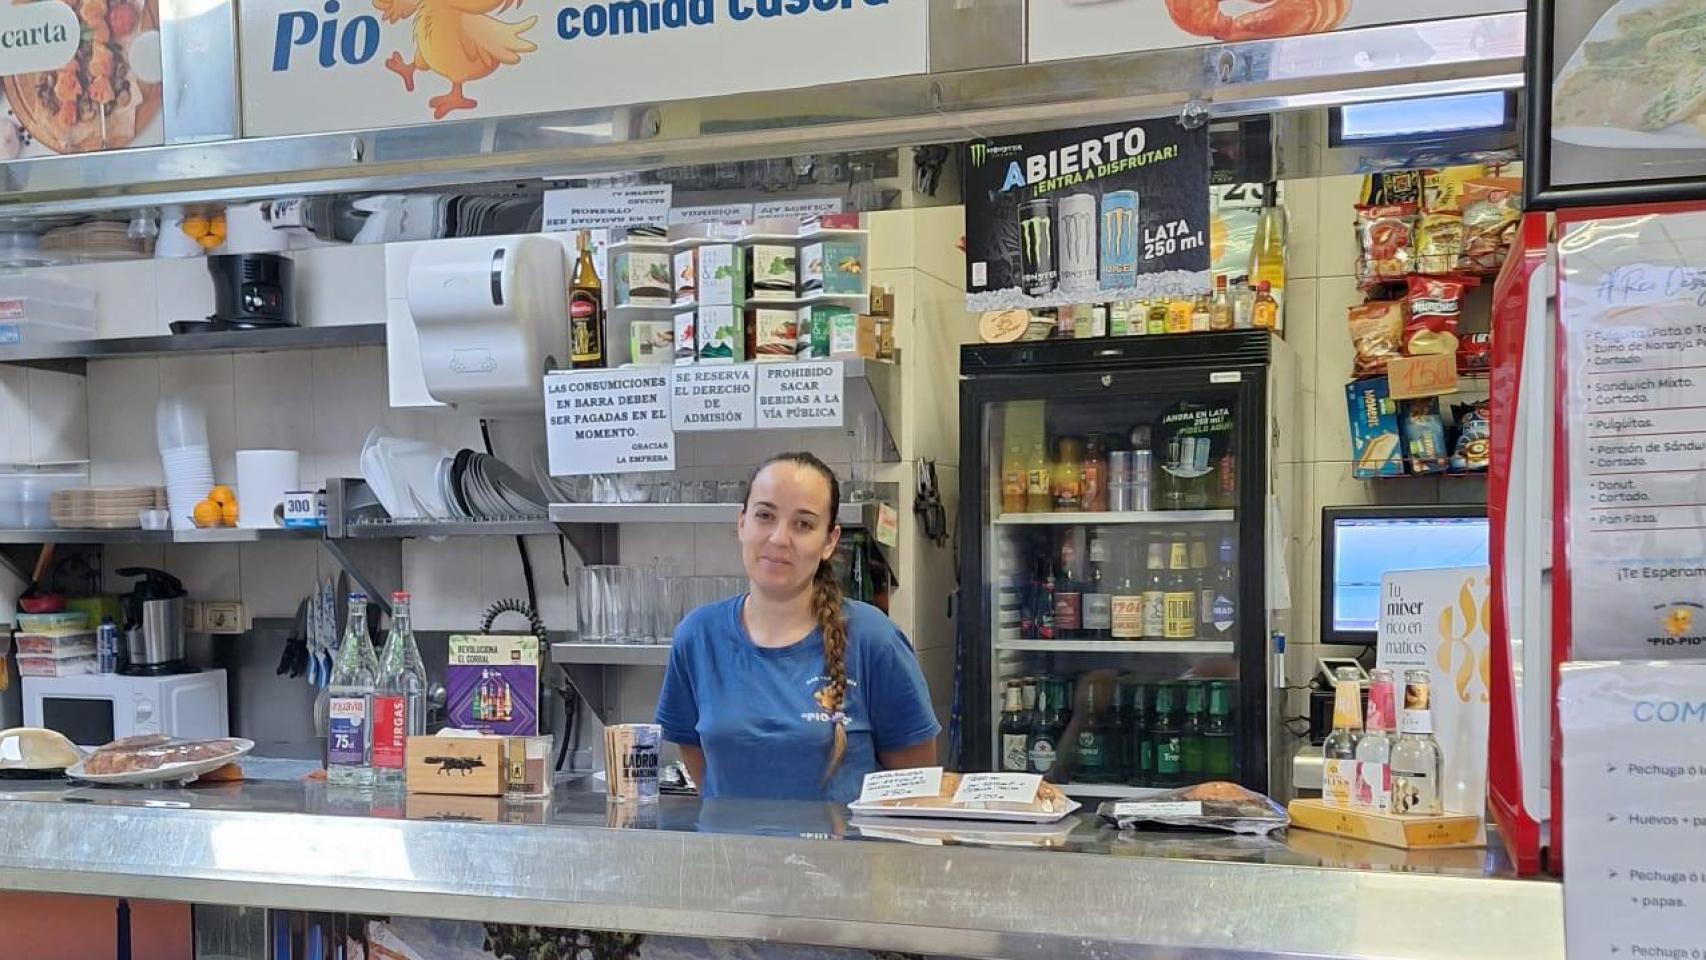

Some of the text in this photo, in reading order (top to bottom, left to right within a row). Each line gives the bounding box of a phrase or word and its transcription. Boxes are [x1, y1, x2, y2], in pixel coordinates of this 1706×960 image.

[556, 0, 714, 40] comida
[1, 21, 67, 48] carta
[272, 0, 381, 72] Pio
[999, 127, 1146, 192] ABIERTO
[1033, 144, 1178, 197] ¡ENTRA A DISFRUTAR!
[1144, 219, 1190, 243] LATA
[1144, 230, 1204, 260] 250 ml
[676, 371, 750, 383] SE RESERVA
[767, 366, 833, 379] PROHIBIDO
[548, 376, 667, 394] LAS CONSUMICIONES
[674, 383, 751, 397] EL DERECHO
[780, 380, 819, 392] SACAR
[556, 393, 658, 410] EN BARRA DEBEN
[704, 399, 721, 409] DE
[760, 393, 840, 406] BEBIDAS A LA
[550, 408, 667, 426] SER PAGADAS EN EL
[683, 410, 742, 423] ADMISIÓN
[763, 405, 837, 419] VÍA PÚBLICA
[1208, 407, 1230, 418] LATA
[575, 426, 640, 440] MOMENTO.
[631, 441, 669, 451] GRACIAS
[288, 499, 311, 513] 300
[1618, 567, 1638, 581] ¡Te
[1387, 582, 1401, 598] Tu
[1387, 597, 1424, 616] mixer
[1386, 619, 1422, 635] rico en
[1384, 639, 1428, 655] matices
[393, 702, 403, 746] FIRGAS
[1628, 813, 1679, 825] Huevos
